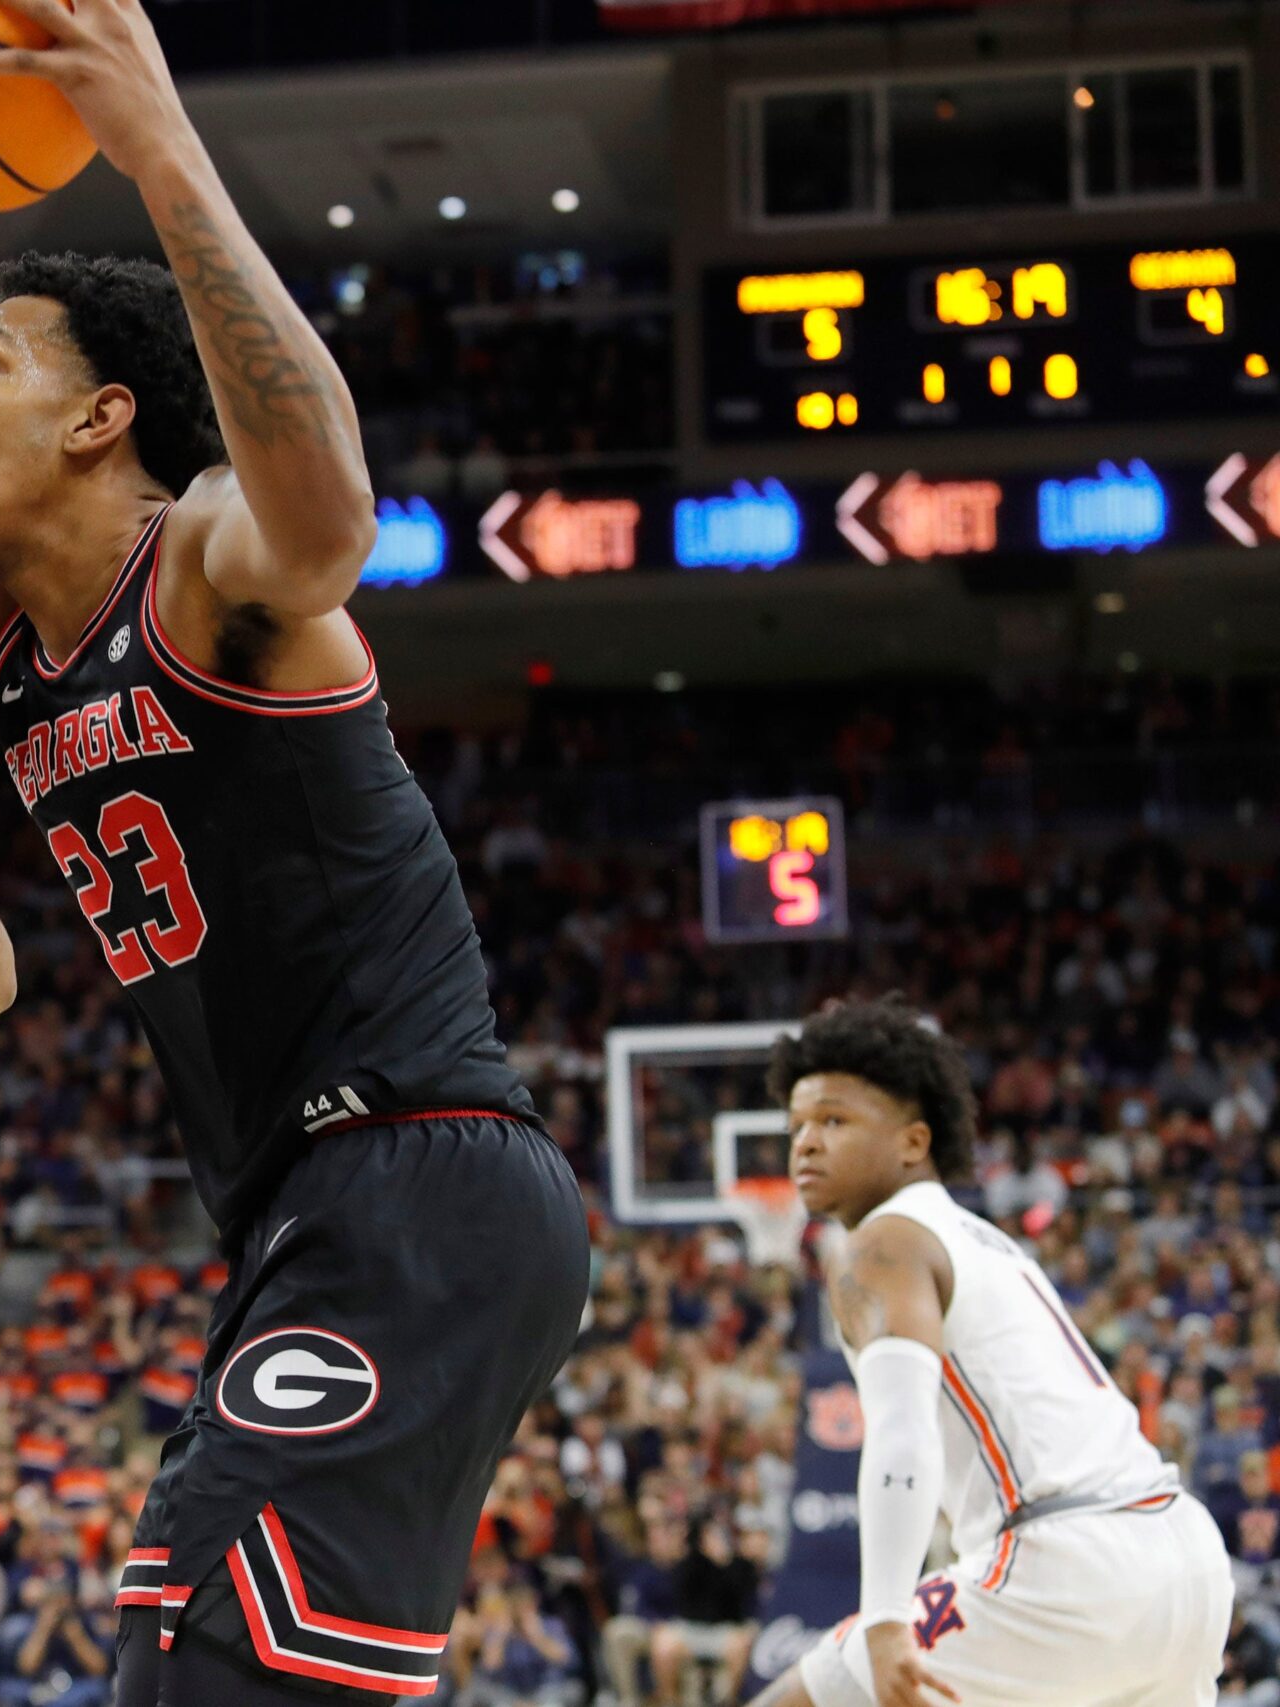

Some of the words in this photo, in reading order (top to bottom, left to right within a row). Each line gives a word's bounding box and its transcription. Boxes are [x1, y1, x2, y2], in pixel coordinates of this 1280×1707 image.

[109, 627, 130, 660] SEC
[48, 790, 208, 986] 23
[769, 850, 819, 926] 5
[303, 1094, 332, 1118] 44
